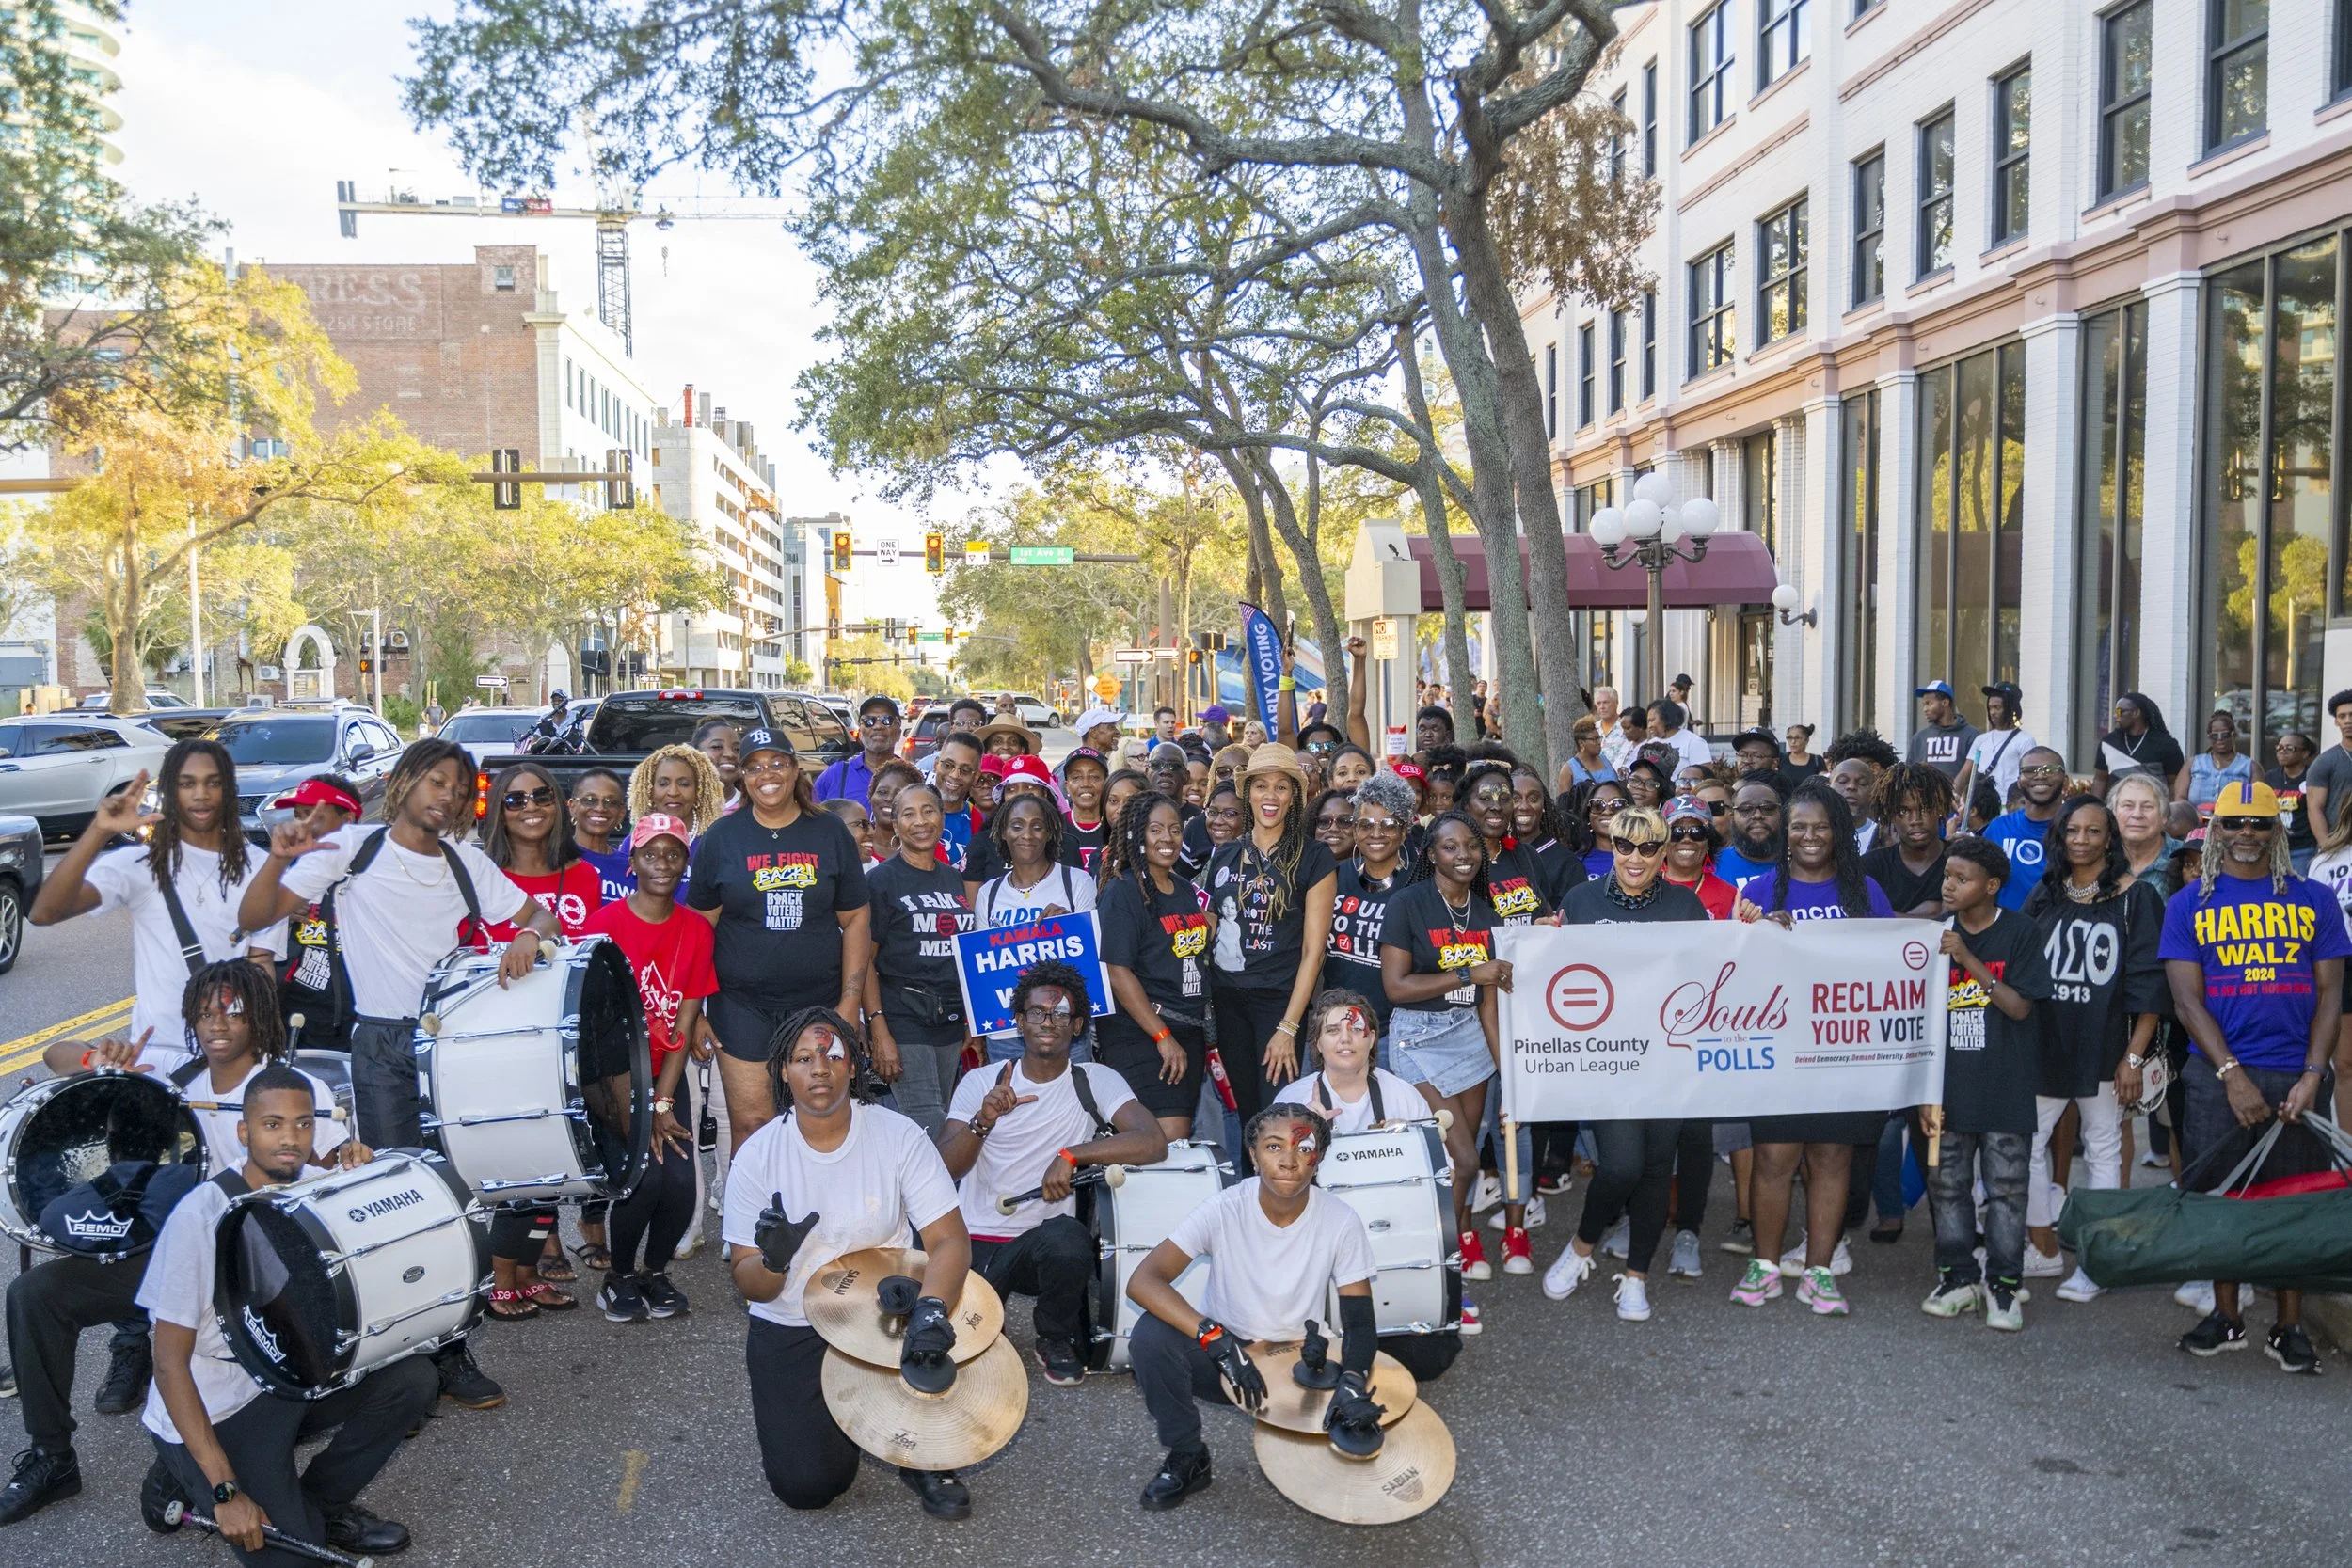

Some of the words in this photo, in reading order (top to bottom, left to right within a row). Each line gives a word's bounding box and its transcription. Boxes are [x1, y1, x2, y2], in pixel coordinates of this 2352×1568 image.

[292, 271, 426, 316] RESS
[1375, 622, 1386, 634] NO
[1254, 623, 1277, 684] VOTING
[749, 729, 771, 745] TB
[650, 815, 671, 830] D
[747, 855, 771, 871] WE
[778, 852, 819, 871] FIGHT
[900, 895, 918, 911] I
[922, 891, 960, 910] AM
[766, 905, 803, 916] VOTERS
[1243, 908, 1267, 920] NOT
[1791, 905, 1849, 921] ncn
[765, 916, 803, 928] MATTER
[1160, 913, 1184, 934] WE
[1249, 923, 1273, 936] THE
[2194, 902, 2316, 946] HARRIS
[990, 922, 1064, 947] KAMALA
[1428, 928, 1453, 948] WE
[1245, 939, 1275, 952] LAST
[2216, 942, 2301, 967] WALZ
[975, 936, 1085, 974] HARRIS
[293, 967, 329, 990] MATTER
[2244, 967, 2276, 982] 2024
[1444, 988, 1476, 1003] MATTER
[1812, 979, 1926, 1014] RECLAIM
[2239, 984, 2258, 995] NOT
[1660, 961, 1789, 1051] Souls
[1723, 1036, 1732, 1044] to
[1734, 1034, 1748, 1043] the
[1811, 1019, 1871, 1045] YOUR
[1880, 1016, 1925, 1043] VOTE
[1950, 1024, 1985, 1036] VOTERS
[1514, 1037, 1581, 1054] Pinellas
[1585, 1037, 1649, 1055] County
[1950, 1036, 1986, 1048] MATTER
[1525, 1058, 1575, 1073] Urban
[1580, 1057, 1641, 1075] League
[1697, 1046, 1775, 1072] POLLS
[1794, 1055, 1816, 1064] Defend
[1816, 1055, 1851, 1065] Democracy.
[1851, 1053, 1876, 1062] Demand
[1876, 1052, 1905, 1062] Diversity.
[1350, 1147, 1405, 1162] YAMAHA
[365, 1188, 425, 1218] YAMAHA
[72, 1224, 123, 1235] REMO
[834, 1268, 860, 1296] SABIAN
[248, 1318, 278, 1357] REMO
[1381, 1466, 1420, 1497] SABIAN
